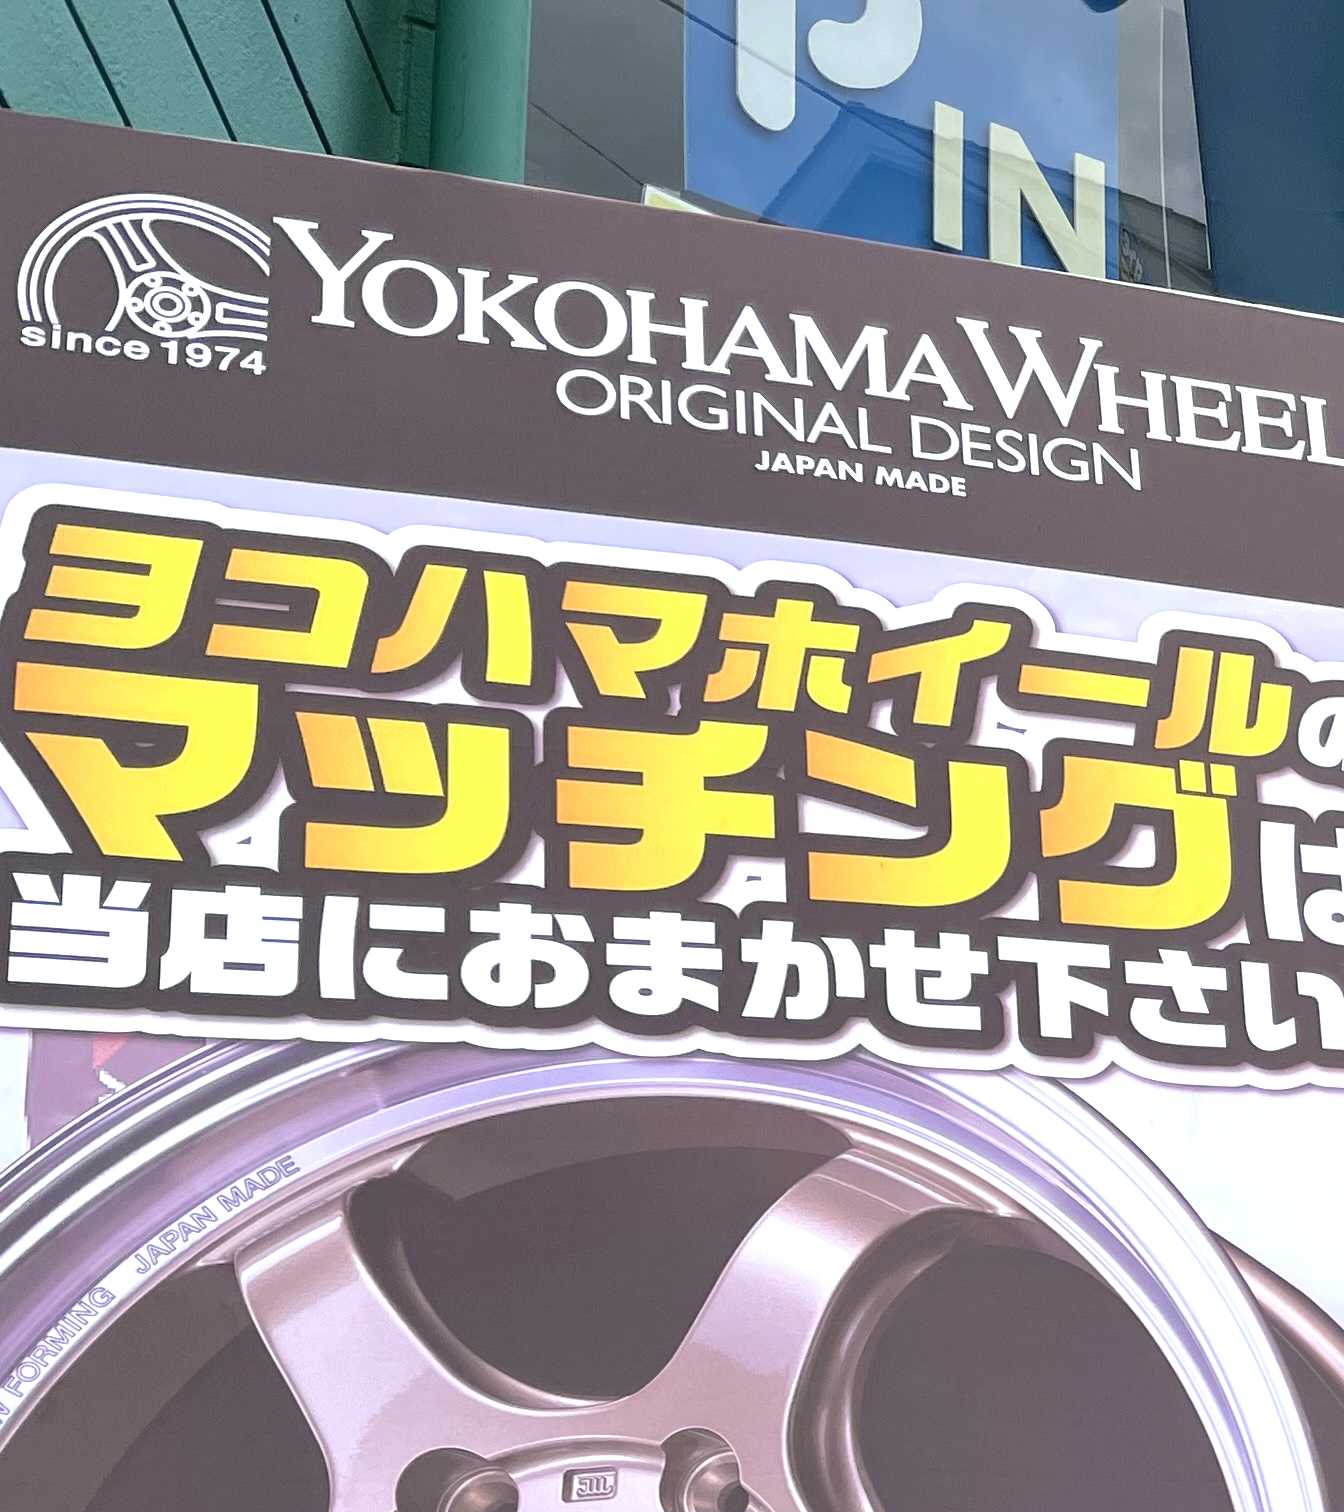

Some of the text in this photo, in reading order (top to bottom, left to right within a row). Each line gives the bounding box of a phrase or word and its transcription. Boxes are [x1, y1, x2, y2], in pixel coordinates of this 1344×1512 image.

[19, 322, 268, 376] since 1974
[272, 215, 957, 412] YOKOHAMA
[555, 368, 1143, 491] ORIGINAL DESIGN
[754, 449, 968, 498] JAPAN MADE
[134, 1153, 301, 1275] JAPAN MADE
[5, 1286, 116, 1398] FORMING
